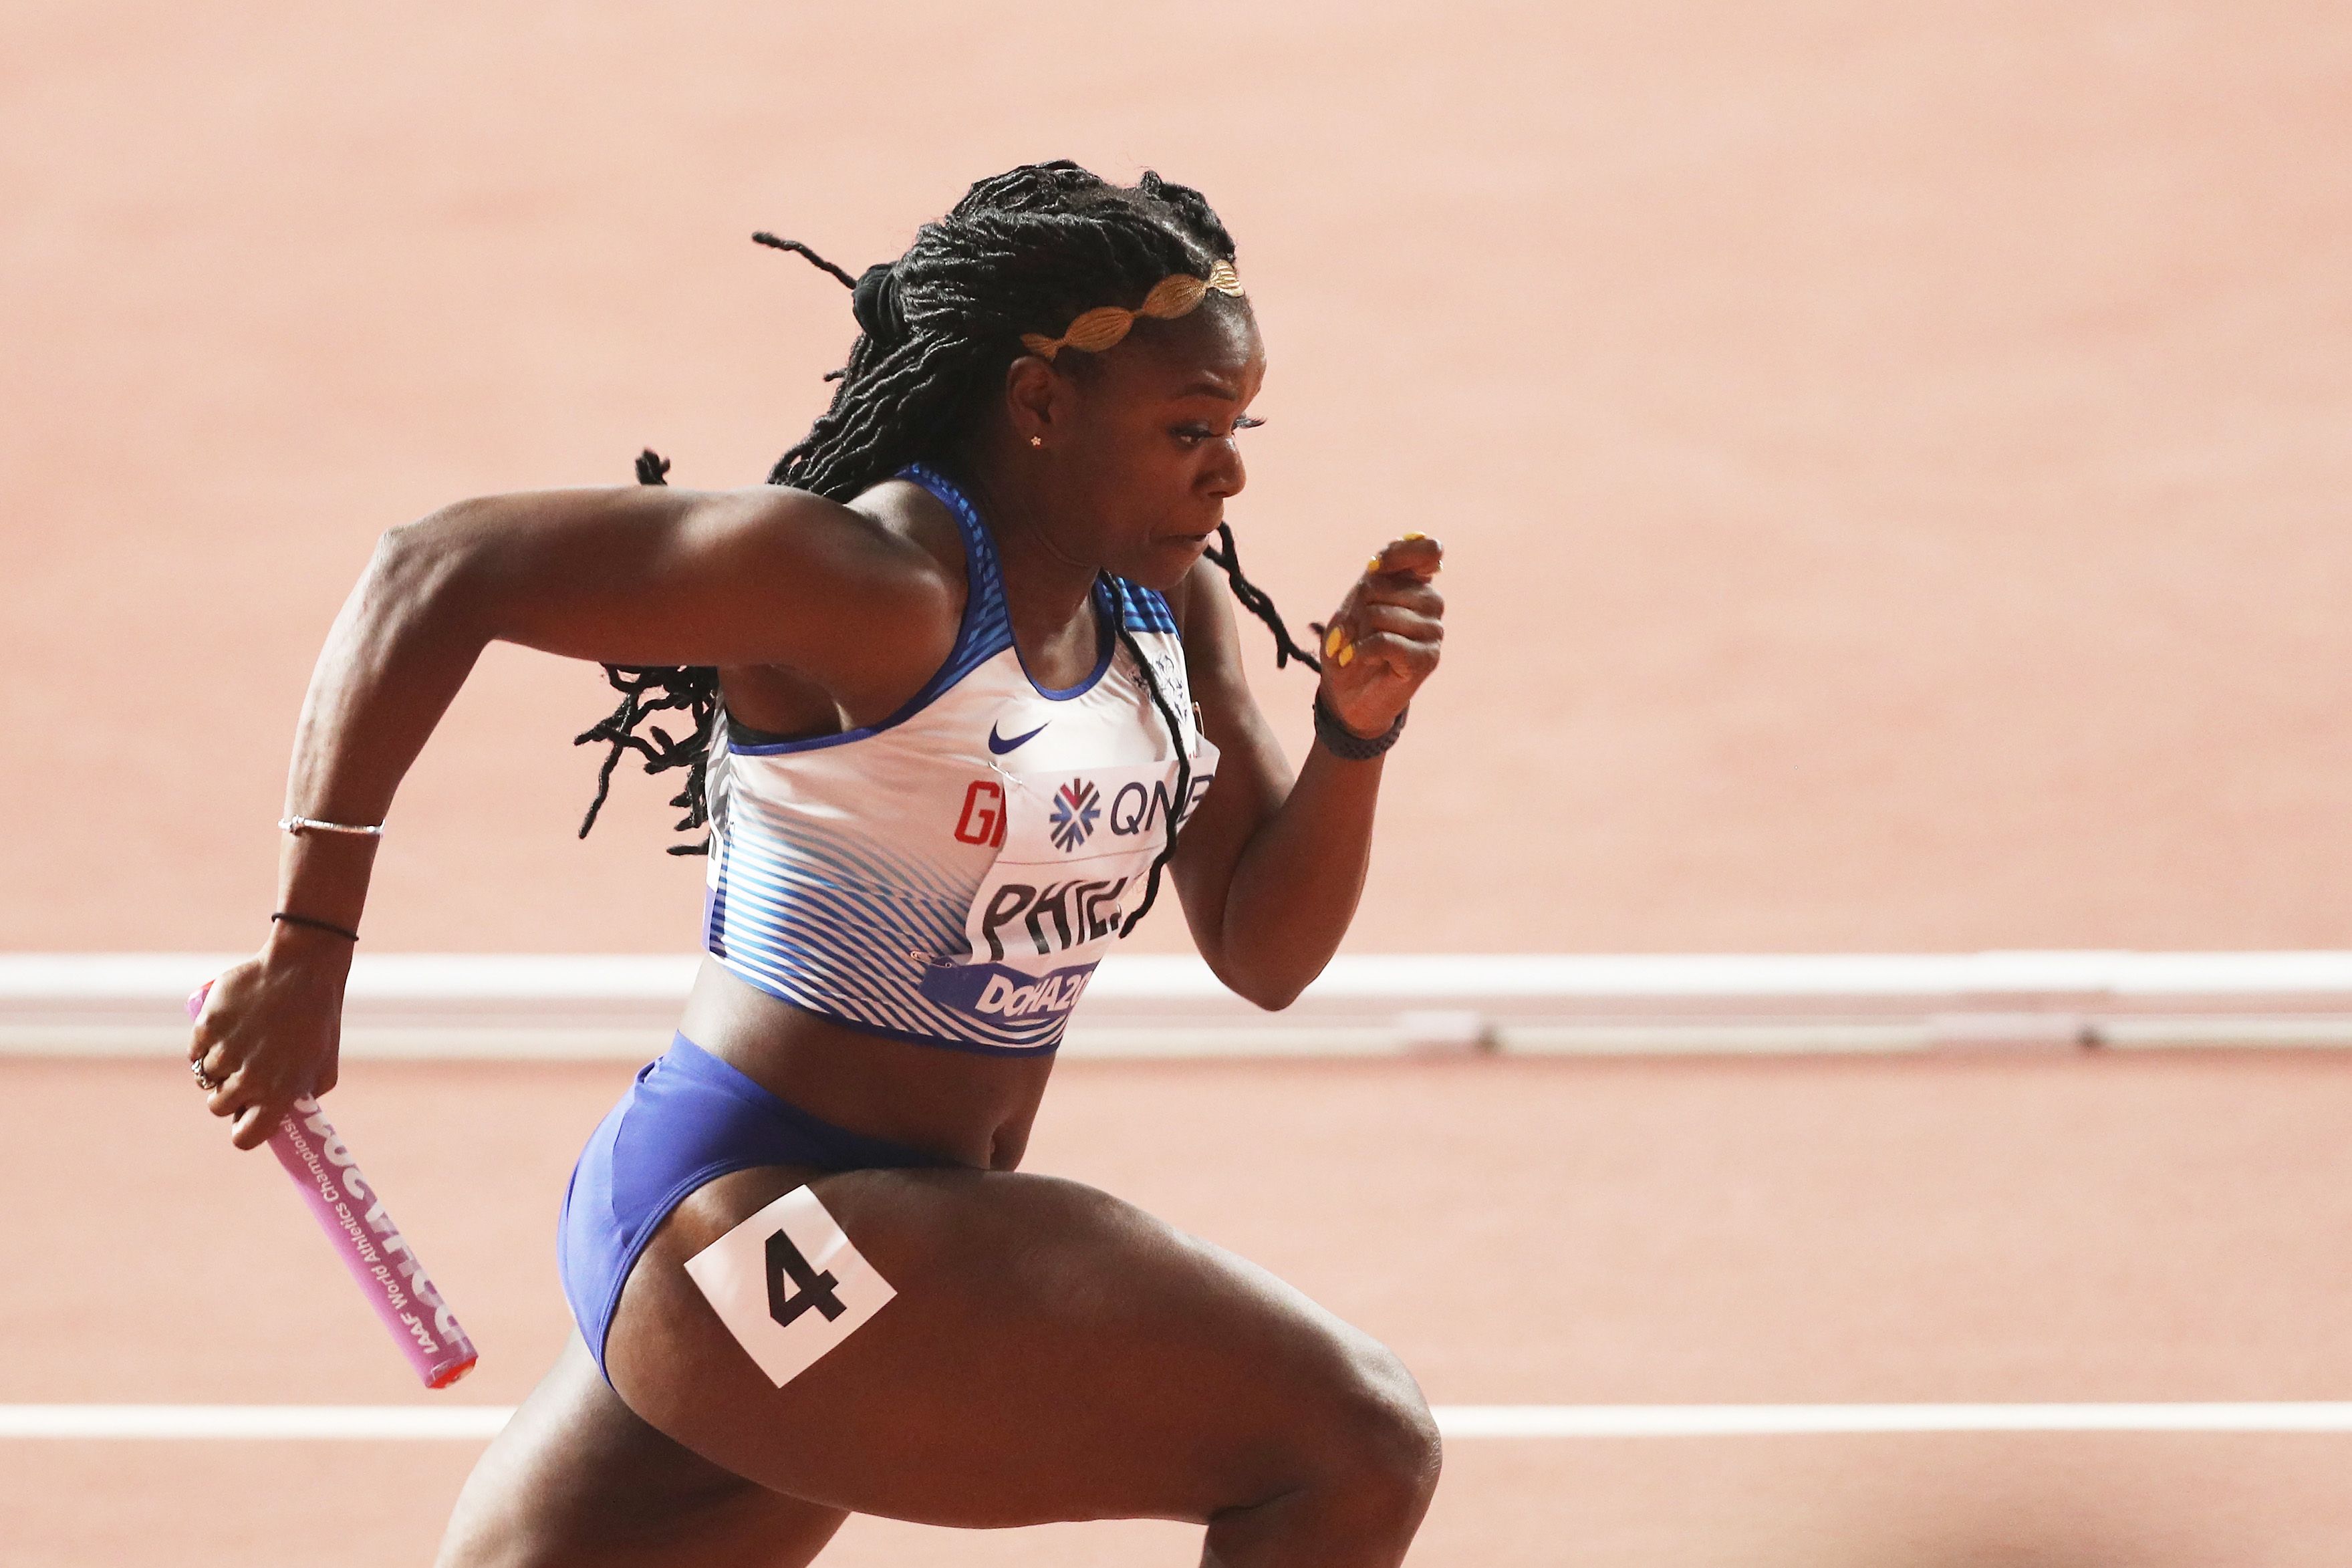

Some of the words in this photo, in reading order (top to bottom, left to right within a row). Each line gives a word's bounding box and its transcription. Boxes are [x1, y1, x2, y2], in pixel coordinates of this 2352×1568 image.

[334, 1201, 381, 1261] Athletics
[370, 1263, 407, 1310] World
[765, 1228, 847, 1327] 4
[398, 1314, 439, 1355] IAAF
